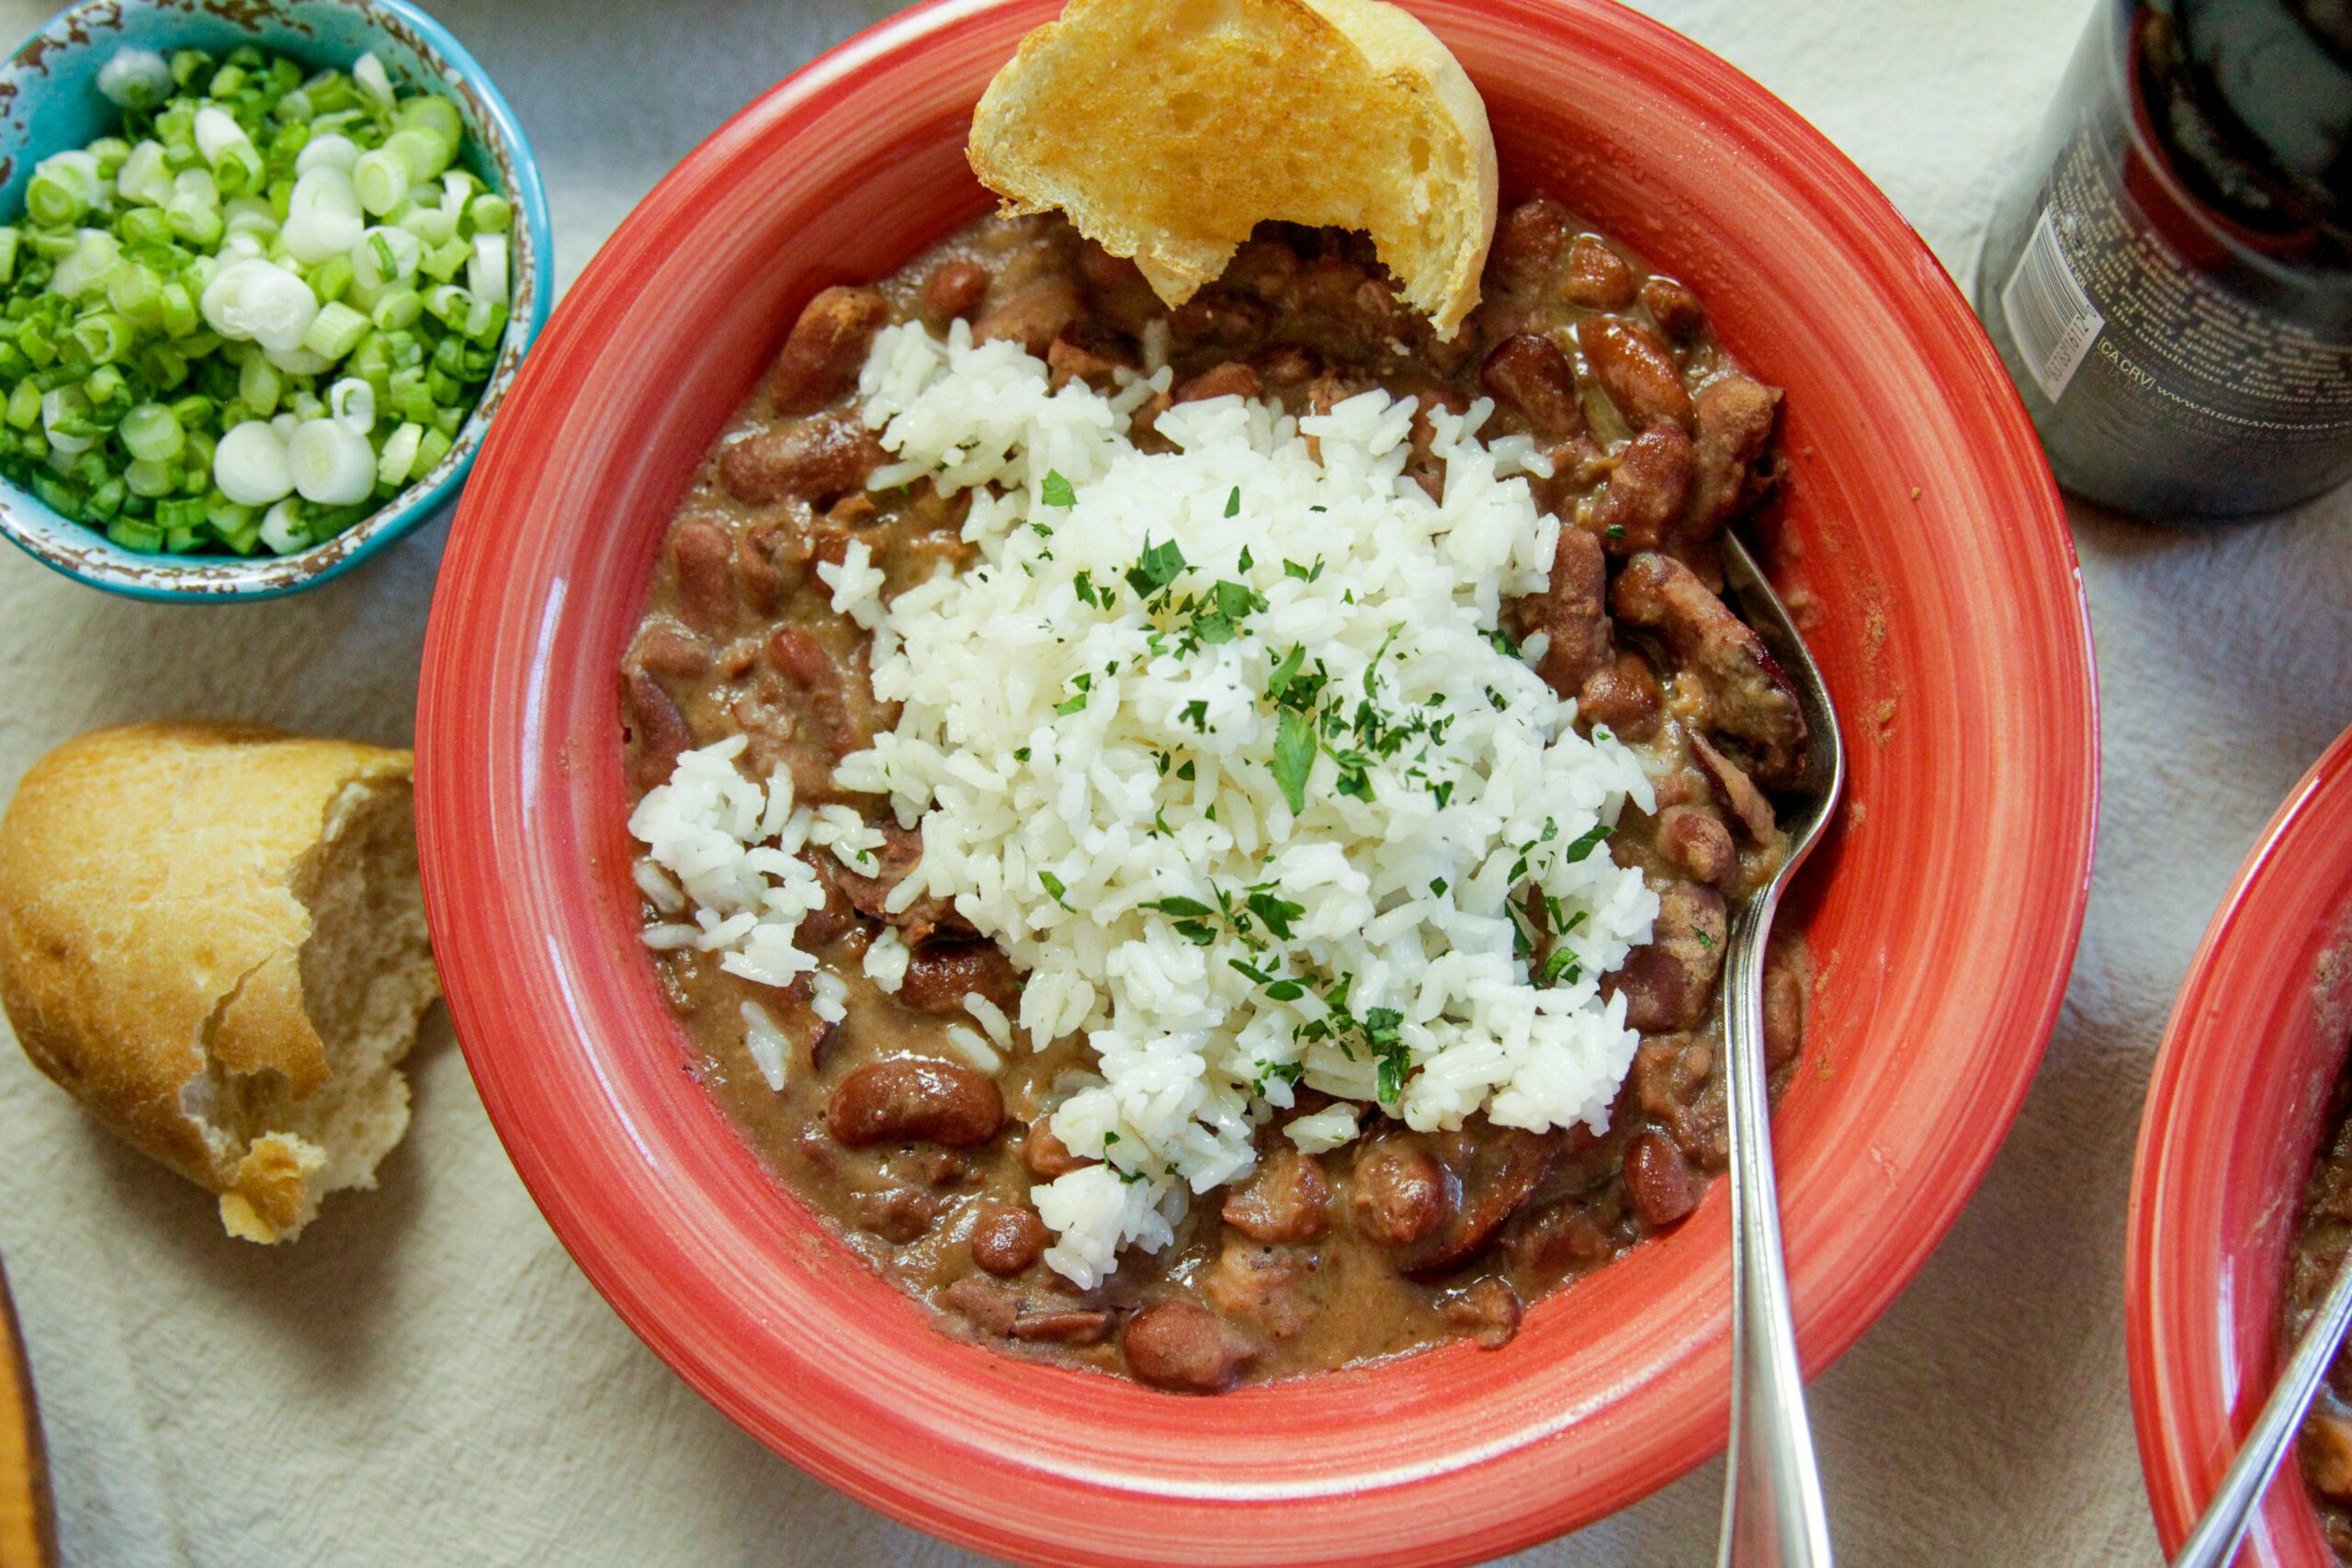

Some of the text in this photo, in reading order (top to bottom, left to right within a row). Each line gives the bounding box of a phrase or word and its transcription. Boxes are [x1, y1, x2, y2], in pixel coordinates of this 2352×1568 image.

[2098, 254, 2120, 284] the
[2094, 281, 2111, 306] for
[2111, 303, 2133, 329] the
[2133, 325, 2222, 386] tumultuous
[2225, 379, 2310, 405] transition
[2101, 342, 2154, 388] CA CRV
